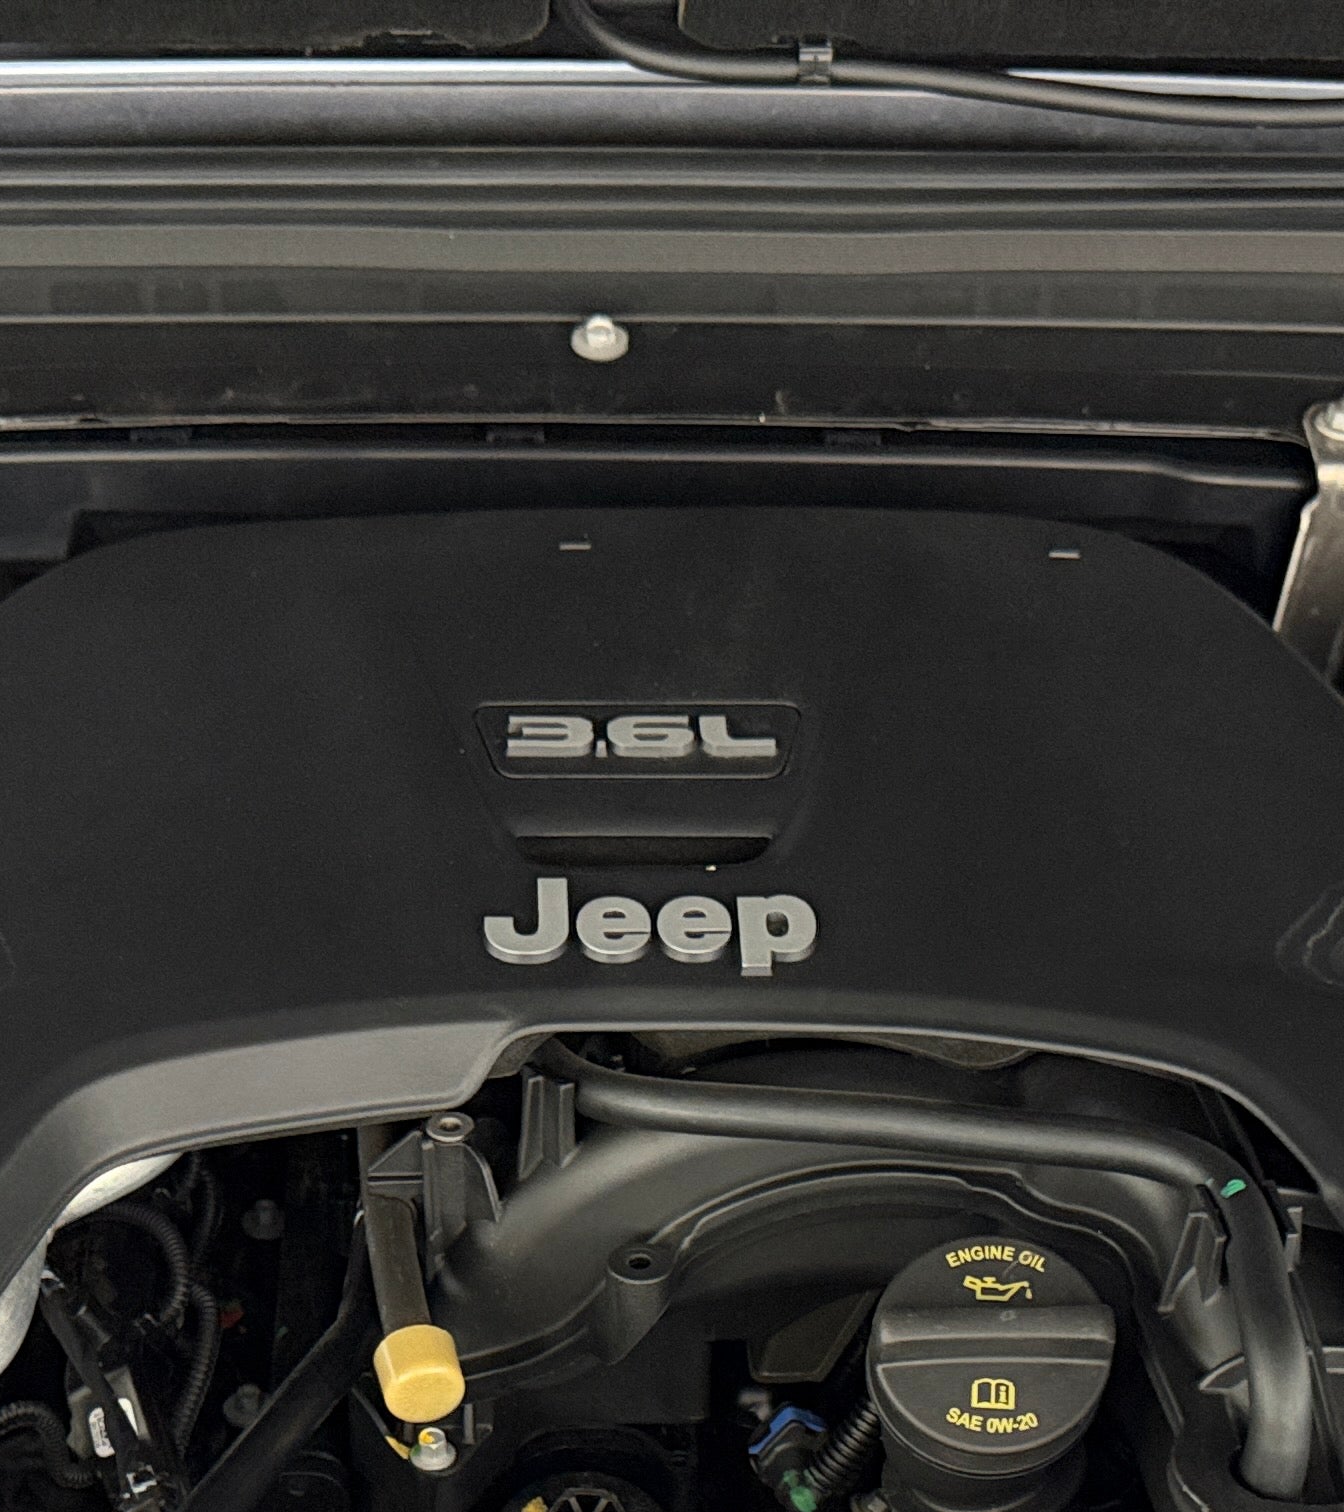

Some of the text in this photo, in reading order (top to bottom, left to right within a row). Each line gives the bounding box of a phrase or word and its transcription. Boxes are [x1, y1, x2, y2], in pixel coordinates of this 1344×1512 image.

[506, 714, 777, 758] 3.6L
[484, 877, 816, 976] Jeep
[946, 1245, 1046, 1272] ENGINE OIL
[946, 1406, 1038, 1433] SAE 0W-20
